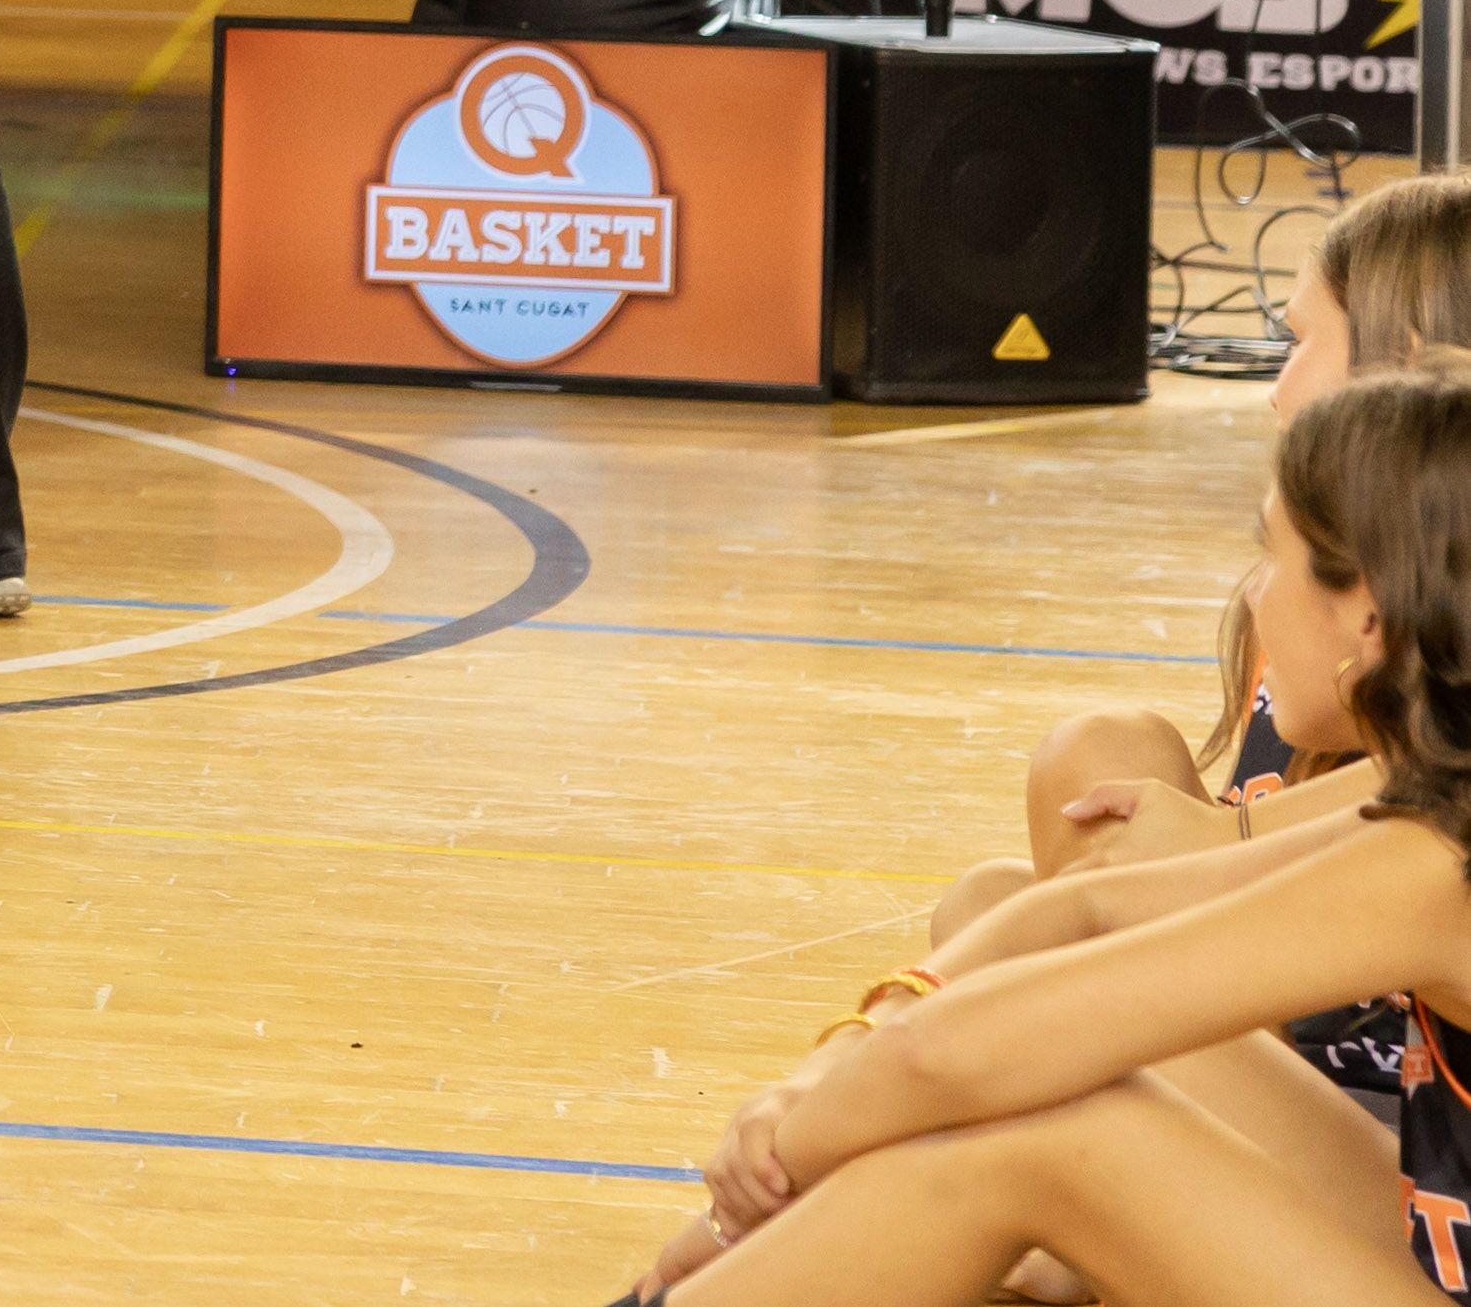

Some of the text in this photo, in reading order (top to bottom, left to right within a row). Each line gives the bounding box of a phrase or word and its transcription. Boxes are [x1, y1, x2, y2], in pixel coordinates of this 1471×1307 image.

[385, 205, 655, 270] BASKET
[449, 297, 591, 318] SANT CUGAT
